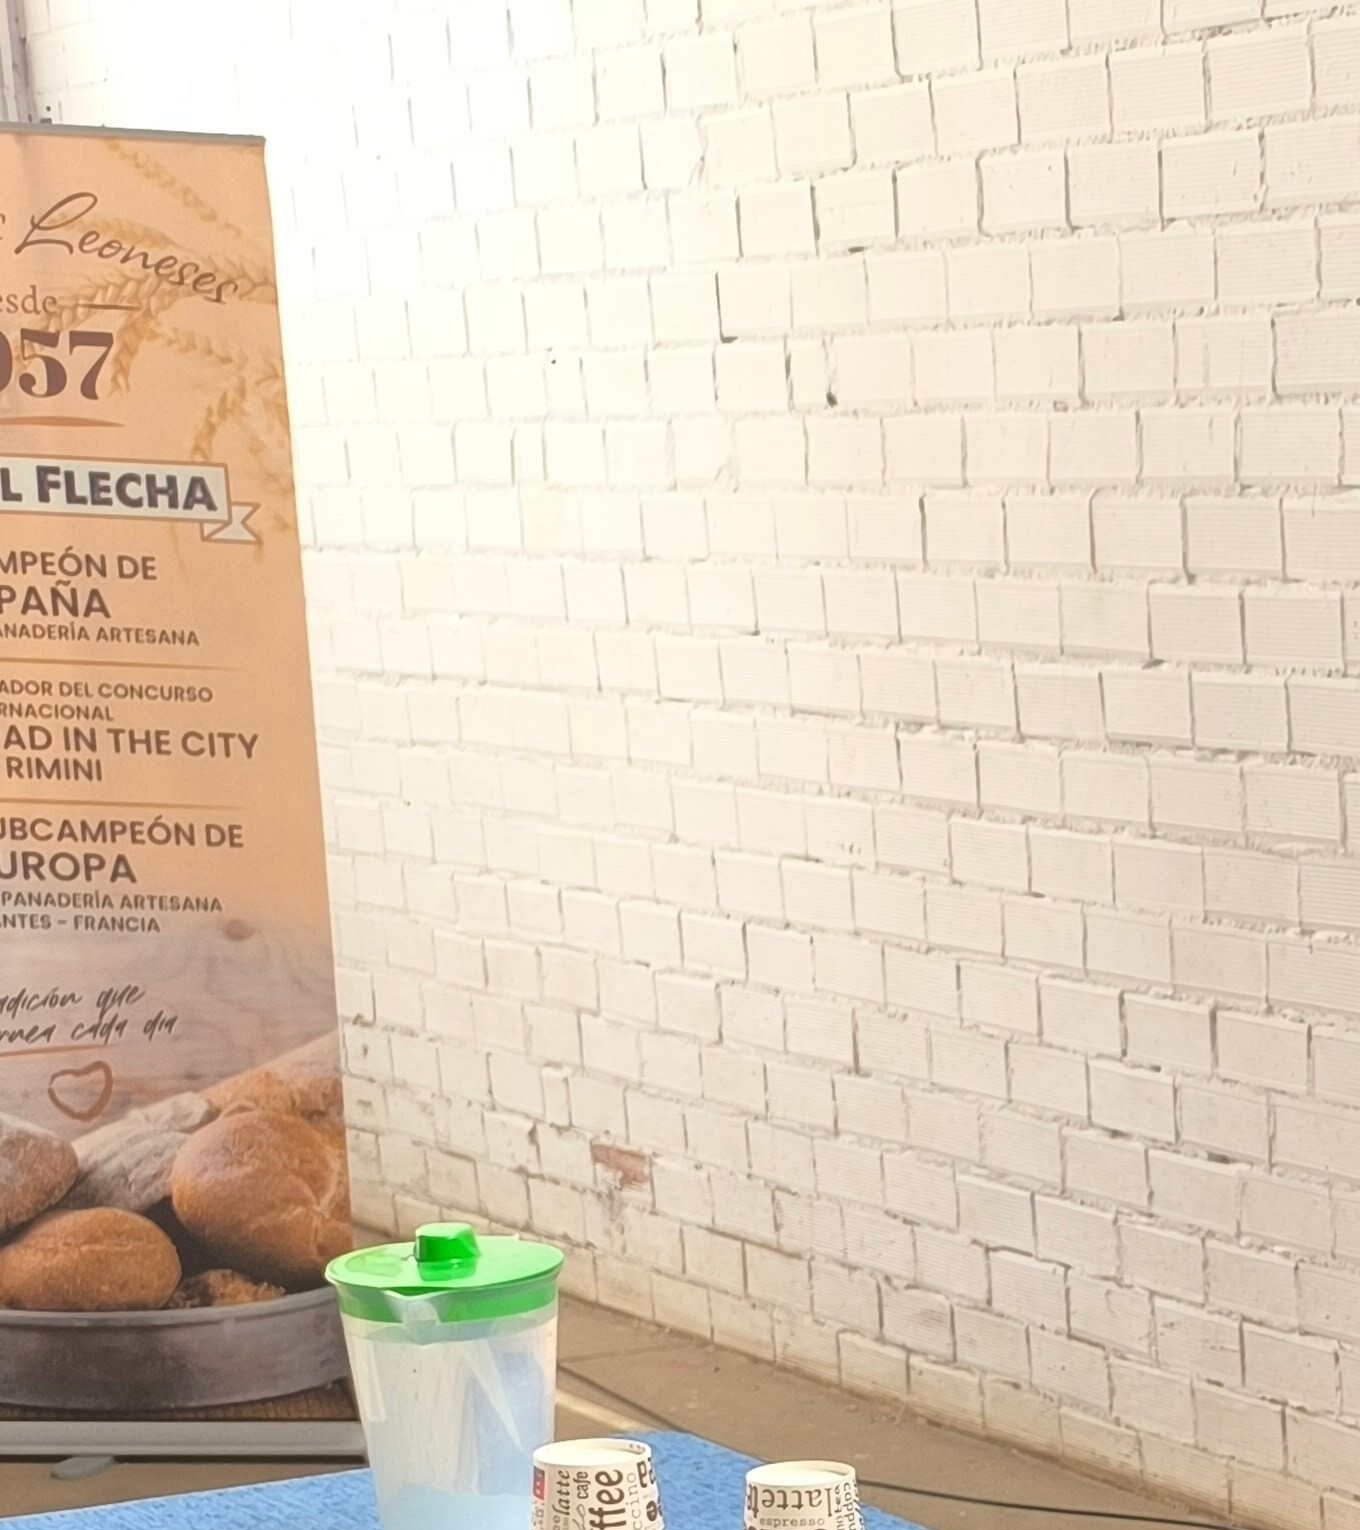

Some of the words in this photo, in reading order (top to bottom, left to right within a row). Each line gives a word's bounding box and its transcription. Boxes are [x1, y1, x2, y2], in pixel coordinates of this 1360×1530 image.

[14, 192, 239, 306] Leoneses
[36, 465, 218, 511] FLECHA
[117, 554, 157, 580] DE
[0, 621, 91, 641] NADERÍA
[96, 626, 200, 646] ARTESANA
[59, 681, 93, 698] DEL
[98, 682, 213, 703] CONCURSO
[63, 727, 97, 752] IN
[107, 728, 171, 755] THE
[181, 731, 259, 759] CITY
[6, 755, 102, 782] RIMINI
[205, 823, 245, 848] DE
[1, 889, 114, 909] PANADERÍA
[120, 893, 223, 912] ARTESANA
[73, 914, 160, 933] FRANCIA
[96, 984, 146, 1022] que
[71, 1013, 128, 1045] cada
[553, 1469, 570, 1517] latte
[573, 1470, 592, 1500] cafe
[762, 1487, 834, 1518] latte
[759, 1517, 826, 1528] espresso
